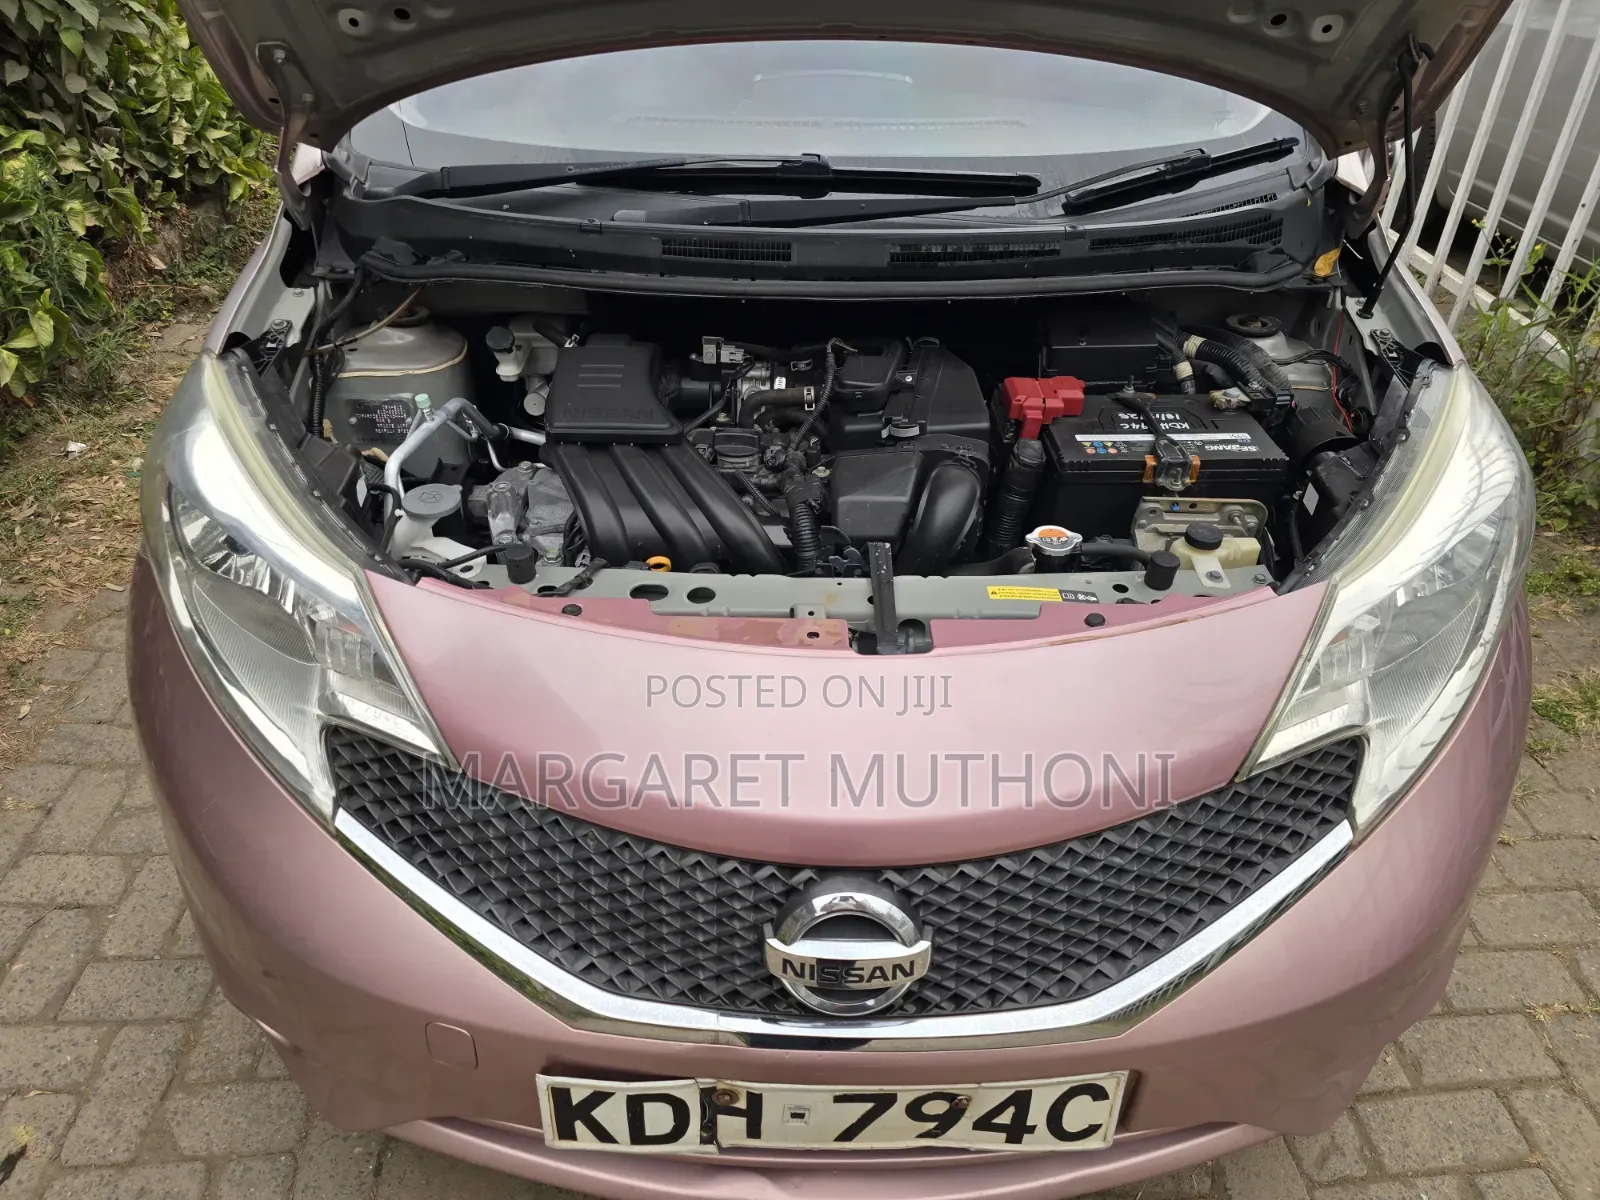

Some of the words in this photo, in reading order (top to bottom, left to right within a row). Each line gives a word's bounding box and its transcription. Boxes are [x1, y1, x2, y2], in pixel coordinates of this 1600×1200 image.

[1160, 422, 1190, 430] KDH
[782, 958, 915, 983] NISSAN
[551, 1086, 763, 1146] KDH
[833, 1082, 1110, 1144] 794C
